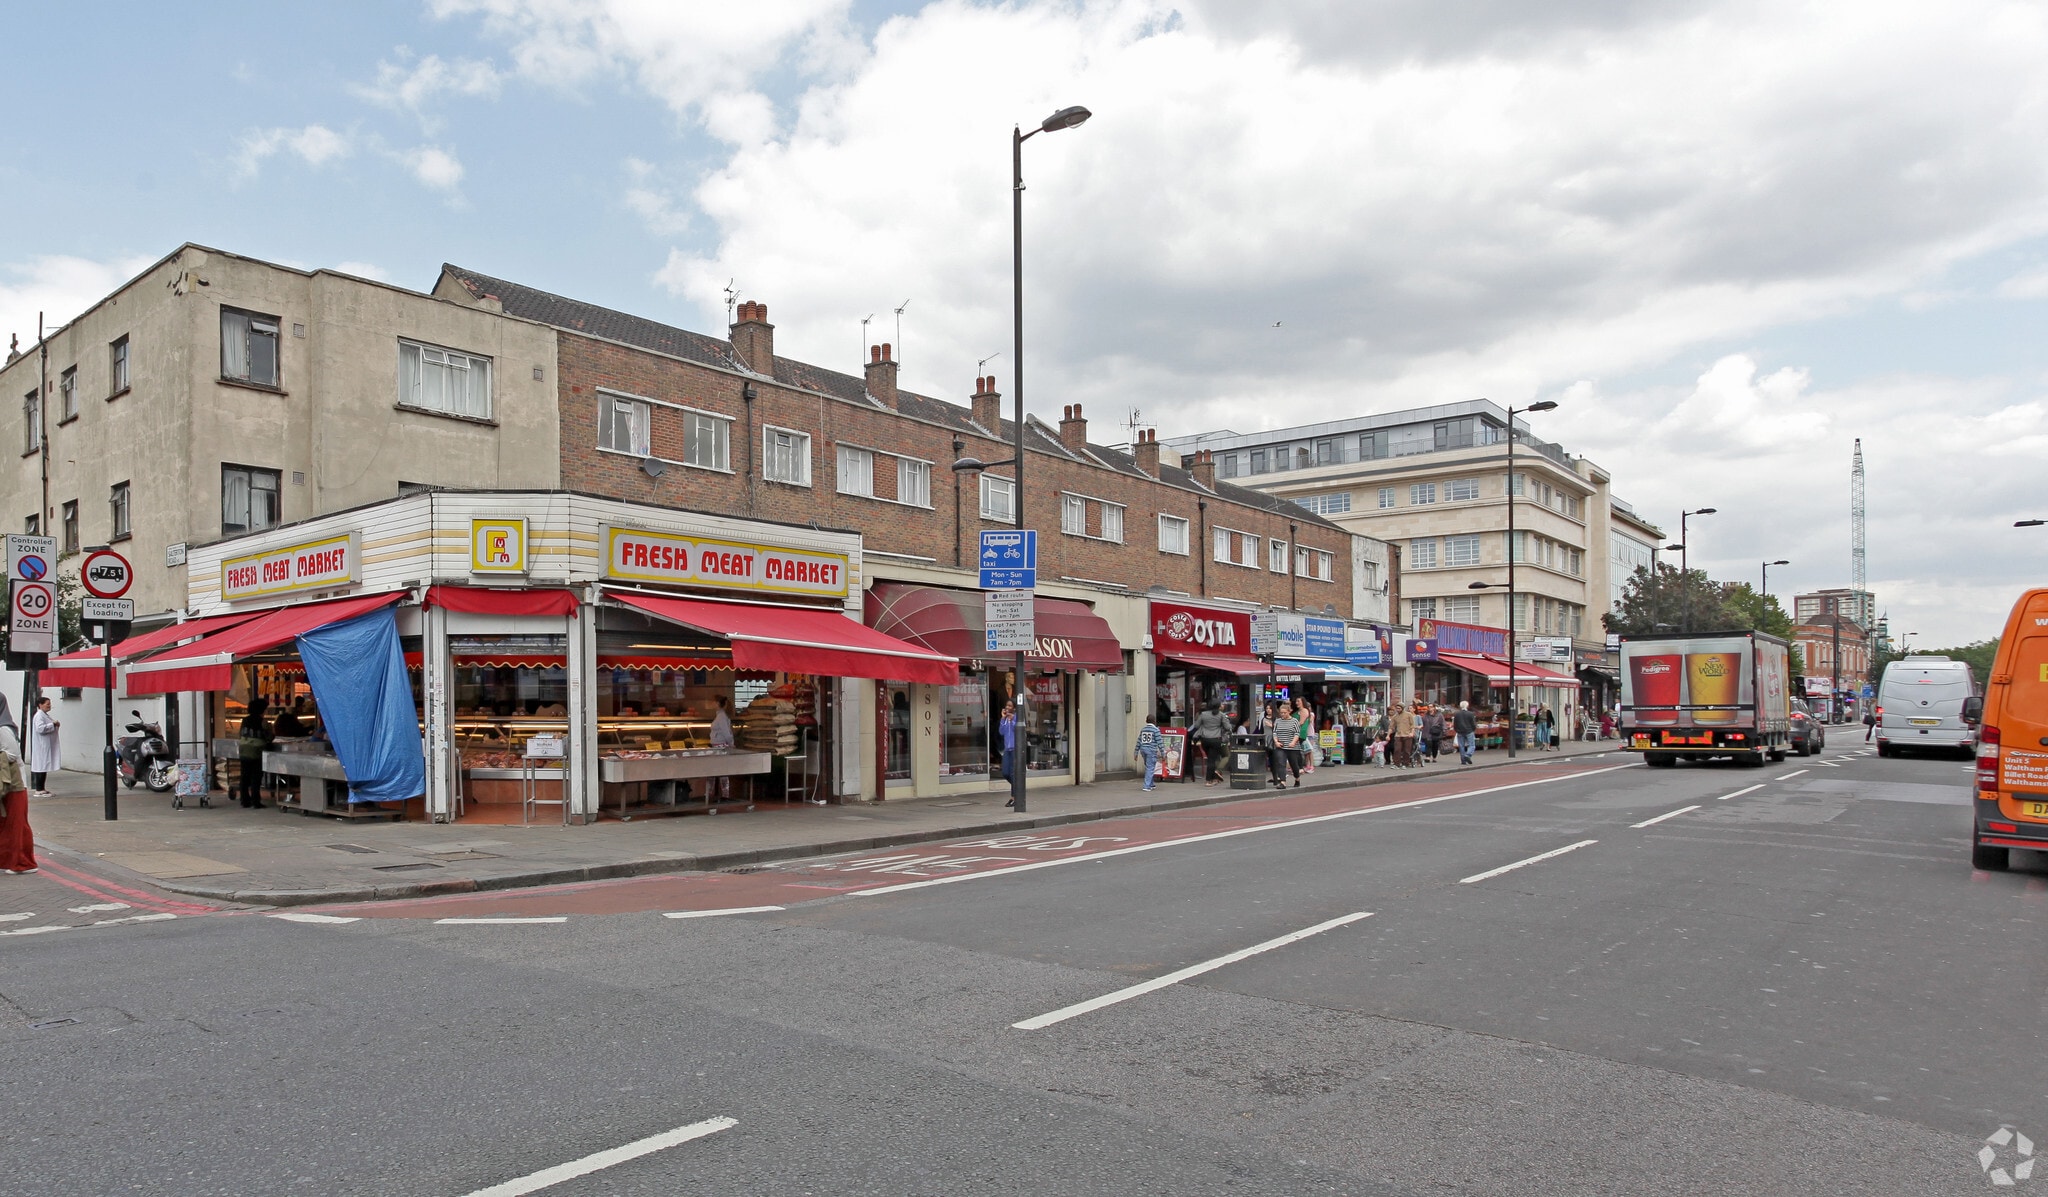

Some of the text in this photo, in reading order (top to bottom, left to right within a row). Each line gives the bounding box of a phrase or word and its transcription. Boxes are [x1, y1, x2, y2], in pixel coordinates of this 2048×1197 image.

[11, 536, 52, 546] Controlled
[17, 545, 46, 553] ZONE
[228, 548, 345, 589] FRESH MEAT MARKET
[622, 542, 839, 585] FRESH MEAT MARKET
[101, 567, 116, 577] 7.5
[22, 594, 46, 608] 20
[86, 601, 115, 609] Except
[93, 609, 124, 617] loading
[1170, 613, 1187, 623] COSTA
[16, 620, 49, 629] ZONE
[1168, 628, 1190, 639] COFFEE
[1186, 618, 1236, 648] OSTA
[1641, 666, 1670, 674] Pedigree
[1698, 667, 1730, 675] WORLD
[953, 678, 979, 694] sale
[1036, 678, 1058, 693] sale
[1142, 733, 1152, 743] 36
[2004, 764, 2043, 772] Waltham
[2027, 772, 2048, 780] Road
[940, 835, 1129, 851] BUS
